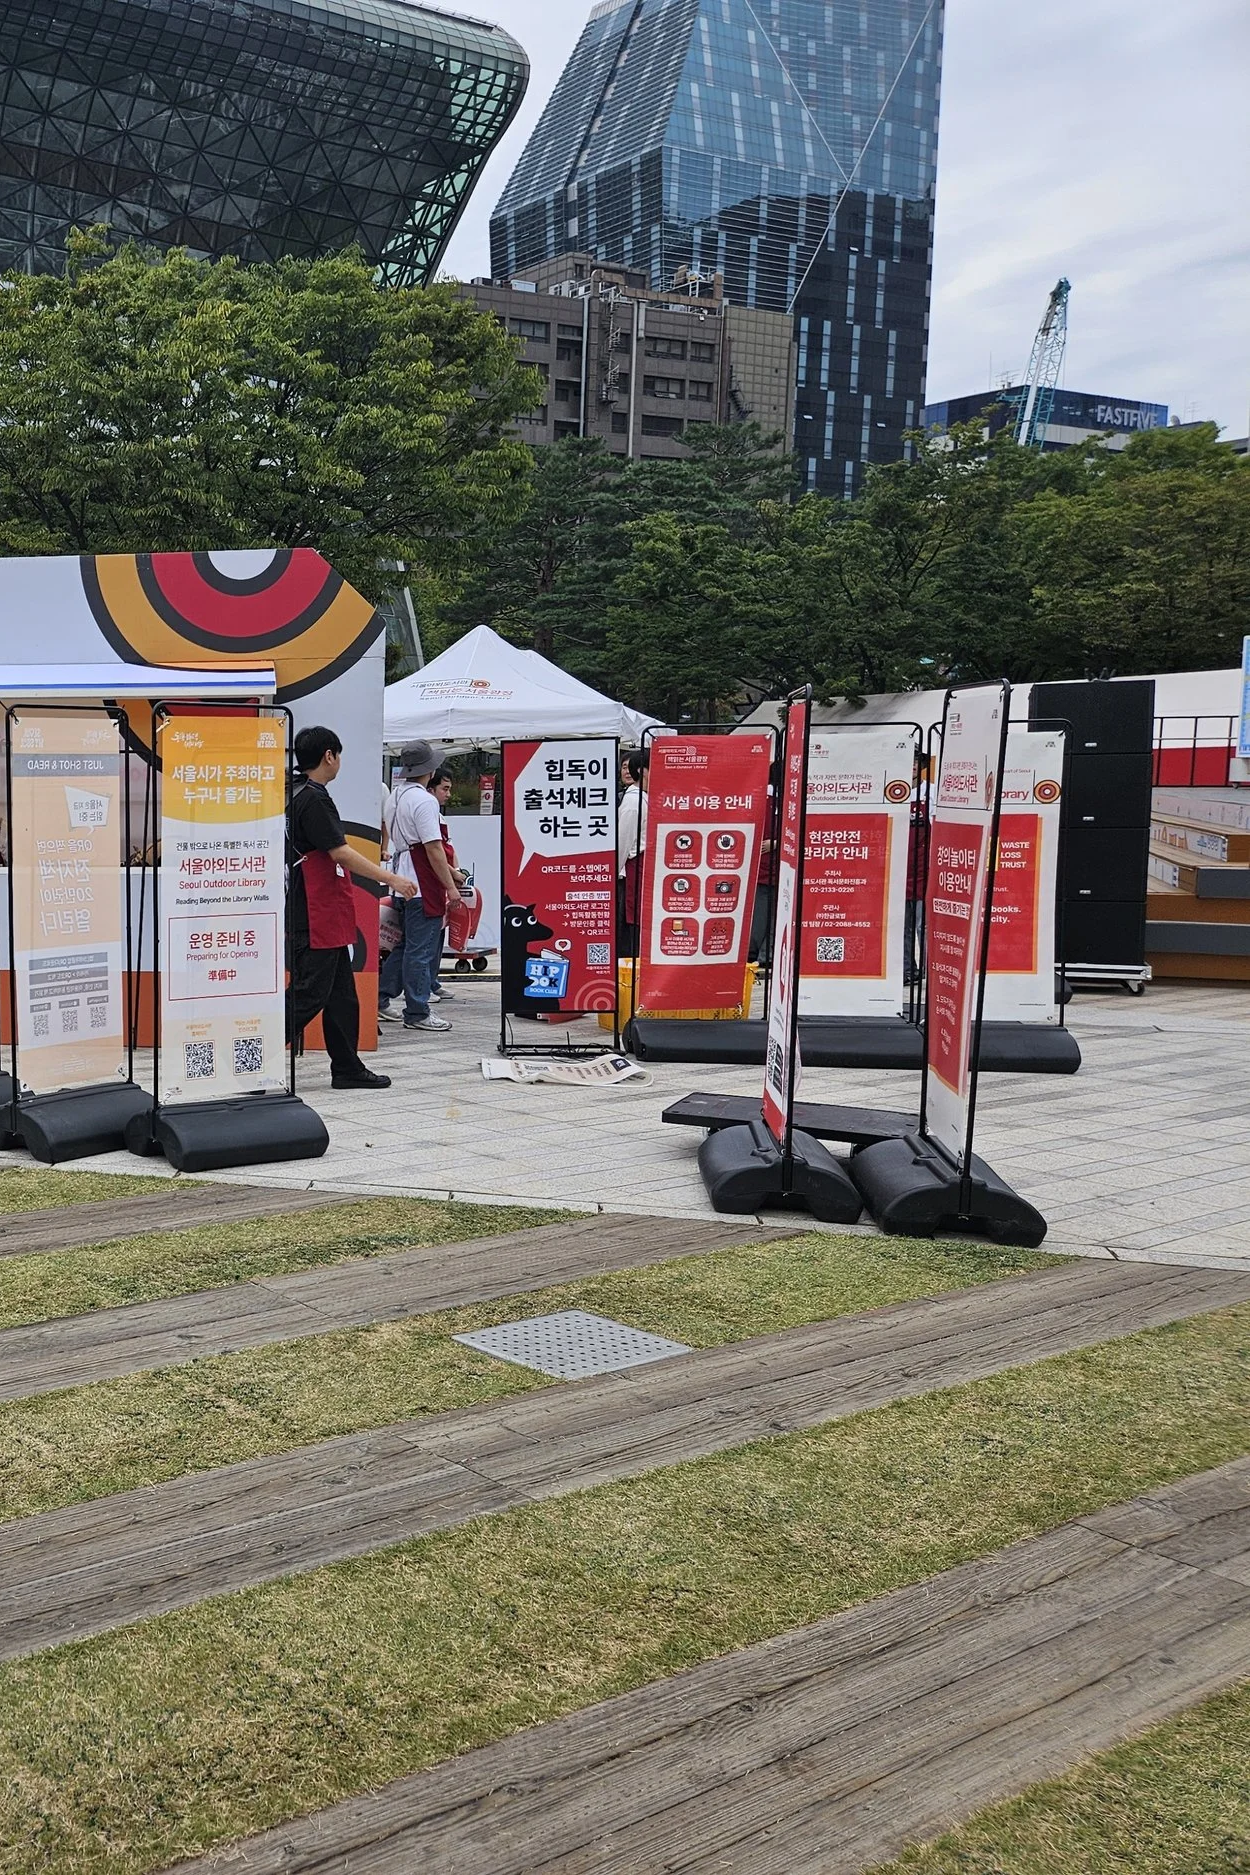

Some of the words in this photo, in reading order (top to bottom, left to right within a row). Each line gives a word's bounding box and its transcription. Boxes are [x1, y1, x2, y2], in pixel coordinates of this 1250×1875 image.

[1097, 405, 1158, 429] FASTFIVE
[172, 765, 222, 783] 서울시가
[225, 766, 275, 782] 주최하고
[545, 758, 607, 781] 힙독이
[183, 788, 221, 804] 누구나
[225, 787, 262, 804] 즐기는
[807, 782, 871, 794] 울야외도서관
[524, 787, 609, 810] 출석체크
[663, 796, 690, 810] 시설
[695, 796, 721, 809] 이용
[725, 795, 752, 809] 안내
[539, 816, 582, 838] 하는
[588, 816, 609, 836] 곳
[809, 831, 860, 844] 현장안전
[176, 842, 188, 851] 건물
[190, 842, 208, 850] 밖으로
[210, 842, 221, 850] 나온
[223, 841, 241, 850] 특별한
[243, 841, 255, 849] 독서
[257, 840, 269, 849] 공간
[842, 847, 868, 859] 안내
[937, 846, 975, 869] 창의놀이터
[179, 856, 266, 875] 서울야외도서관
[542, 865, 576, 873] QR코드를
[179, 880, 201, 889] Seoul
[203, 879, 235, 888] Outdoor
[238, 878, 266, 888] Library
[939, 872, 971, 895] 이용안내
[176, 897, 198, 905] Reading
[200, 897, 221, 905] Beyond
[233, 895, 252, 903] Library
[189, 932, 213, 949] 운영
[217, 931, 240, 947] 준비
[243, 930, 255, 946] 중
[186, 952, 218, 962] Preparing
[230, 950, 258, 959] Opening
[208, 969, 237, 981] 準備中
[531, 965, 560, 977] HIP
